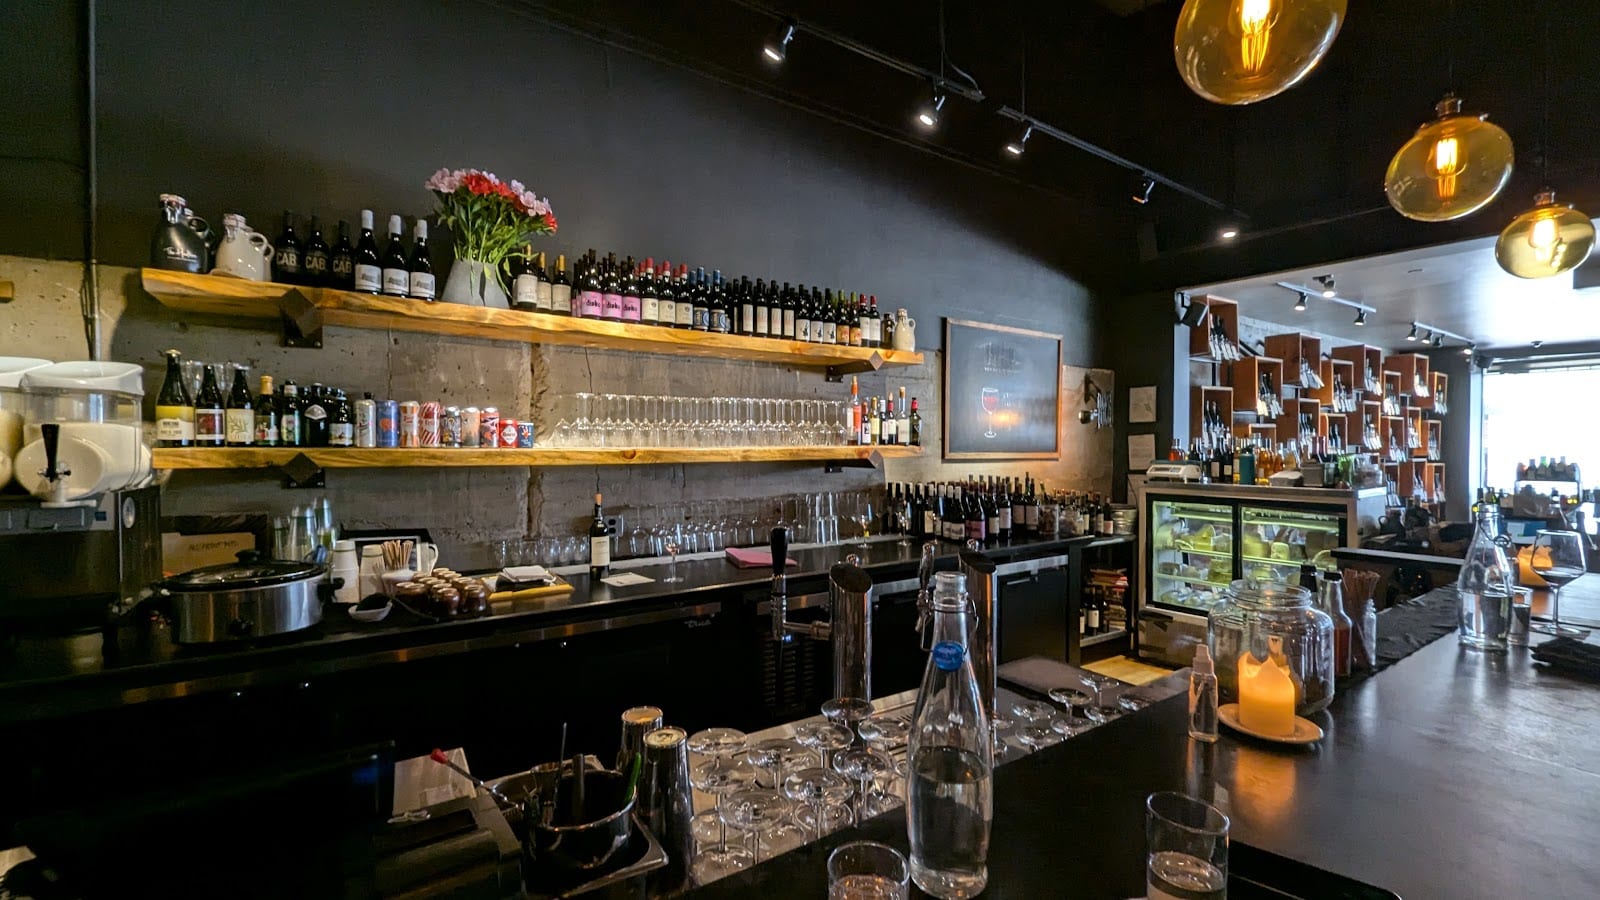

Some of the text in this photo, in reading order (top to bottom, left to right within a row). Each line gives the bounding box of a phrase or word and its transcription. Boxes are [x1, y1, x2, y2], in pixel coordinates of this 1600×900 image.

[276, 252, 297, 266] CAB
[305, 255, 326, 270] CAB
[333, 259, 352, 273] CAB
